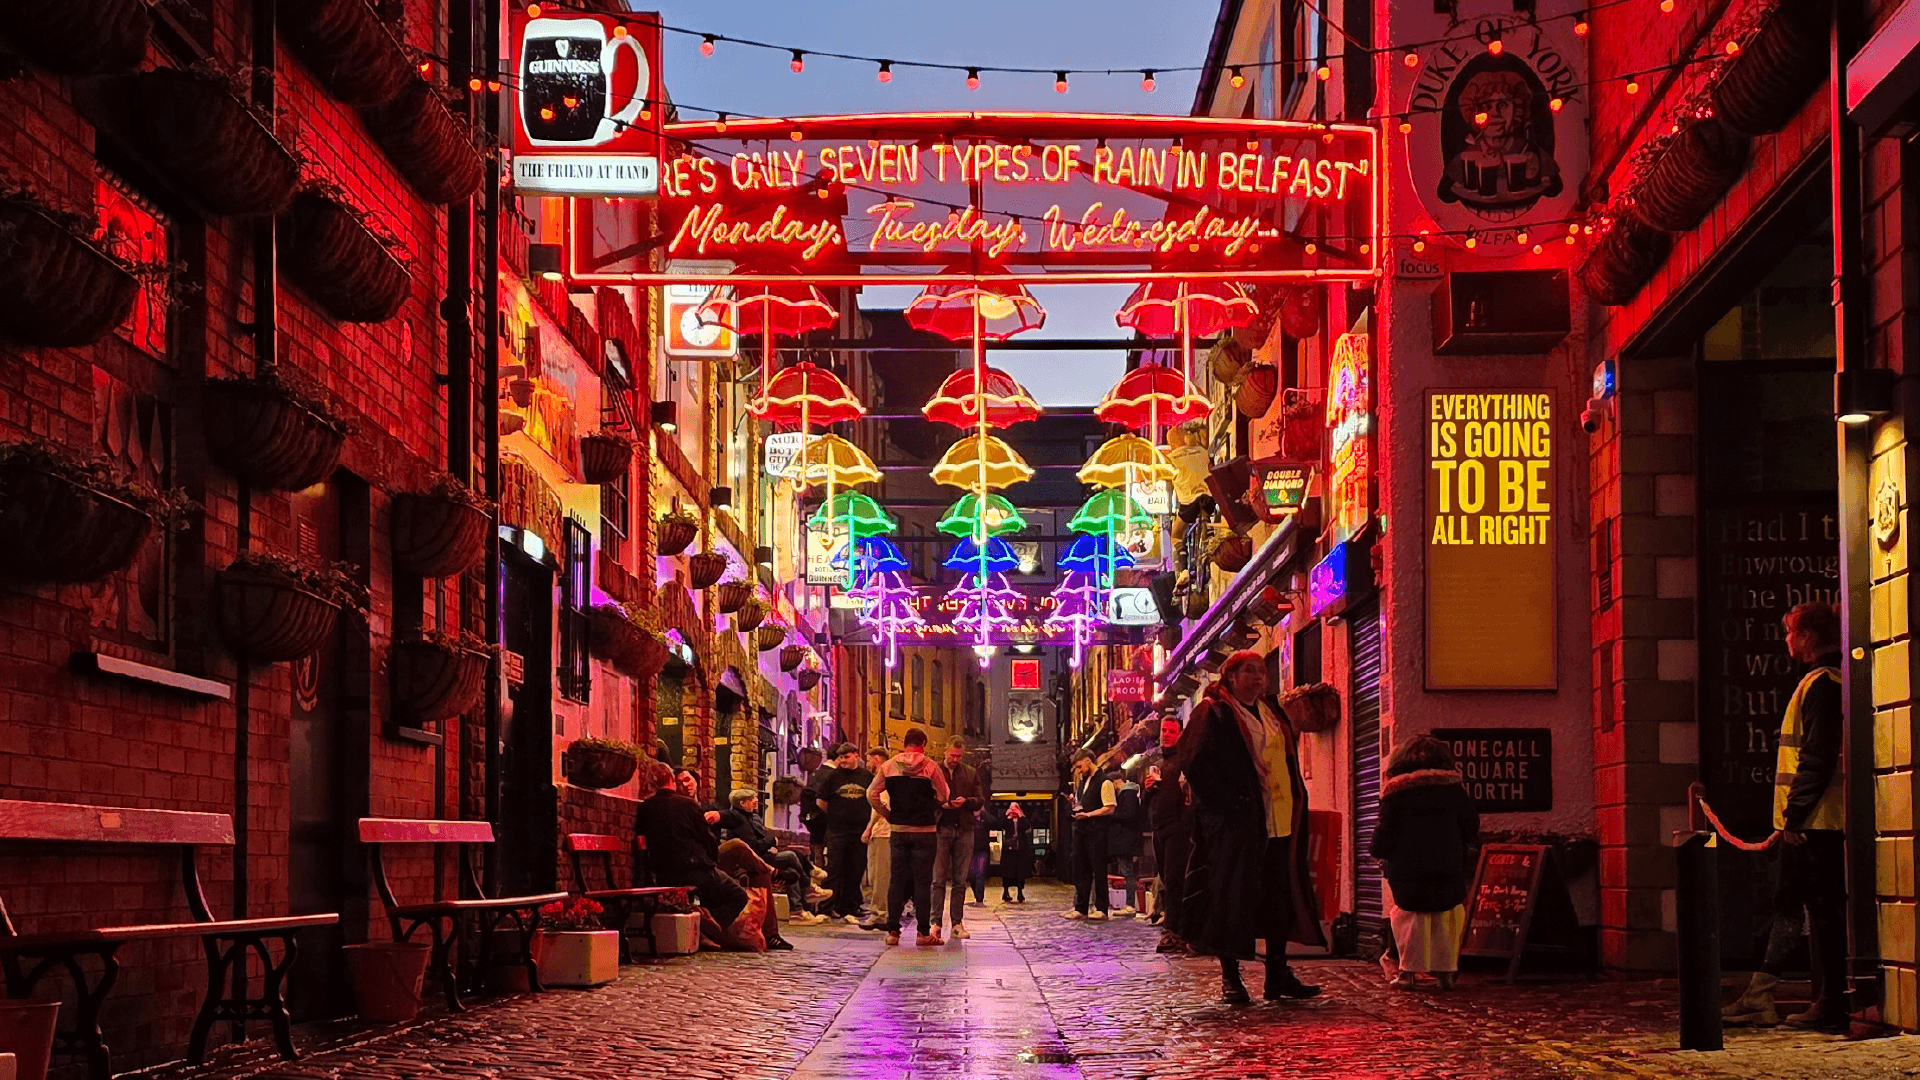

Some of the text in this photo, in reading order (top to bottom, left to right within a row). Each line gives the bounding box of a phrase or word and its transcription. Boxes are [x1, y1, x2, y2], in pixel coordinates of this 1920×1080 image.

[529, 59, 599, 74] GUINNESS
[1411, 19, 1582, 112] DUKE OF YORK
[519, 163, 649, 180] THE FRIEND AT HAND
[731, 148, 804, 191] ONLY
[820, 143, 918, 186] SEVEN
[932, 143, 1029, 184] TYPES
[1041, 143, 1081, 183] OF
[1094, 146, 1168, 188] RAIN
[1176, 147, 1206, 190] IN
[1400, 258, 1440, 274] focus
[1431, 394, 1550, 420] EVERYTHING
[1431, 421, 1550, 458] IS GOING
[1263, 478, 1304, 490] DIAMOND
[1266, 469, 1302, 480] DOUBLE
[1431, 459, 1550, 514] TO BE
[1431, 514, 1550, 545] ALL RIGHT
[1720, 511, 1786, 542] Had
[1720, 584, 1775, 609] The
[1113, 676, 1146, 685] LADIES
[1115, 687, 1144, 695] ROOM
[1454, 761, 1529, 780] SQUARE
[1461, 782, 1524, 800] NORTH
